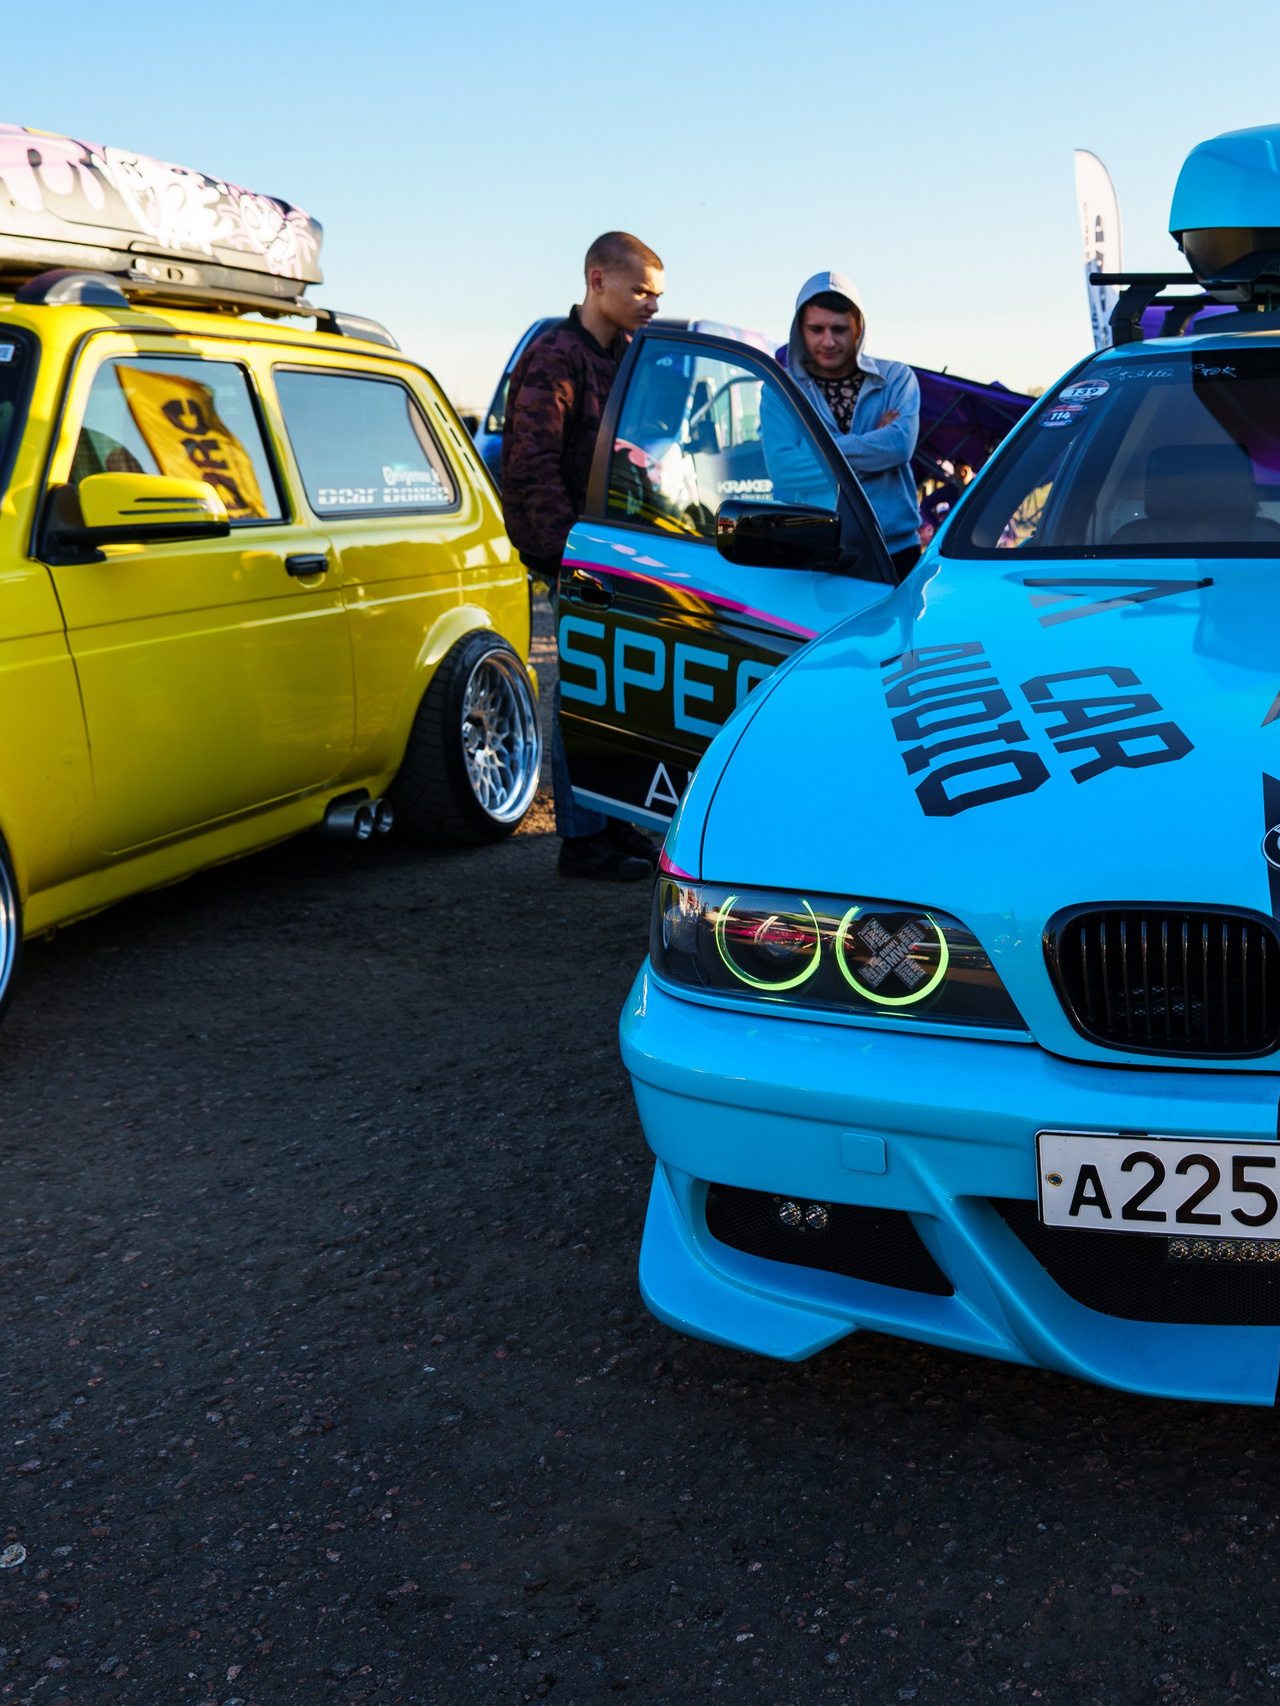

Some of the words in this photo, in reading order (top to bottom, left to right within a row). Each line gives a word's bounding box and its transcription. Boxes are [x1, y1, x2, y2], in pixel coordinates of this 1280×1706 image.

[1050, 411, 1072, 421] 114
[1071, 388, 1100, 396] 139
[880, 641, 1051, 817] AUDIO
[1020, 665, 1195, 785] CAR
